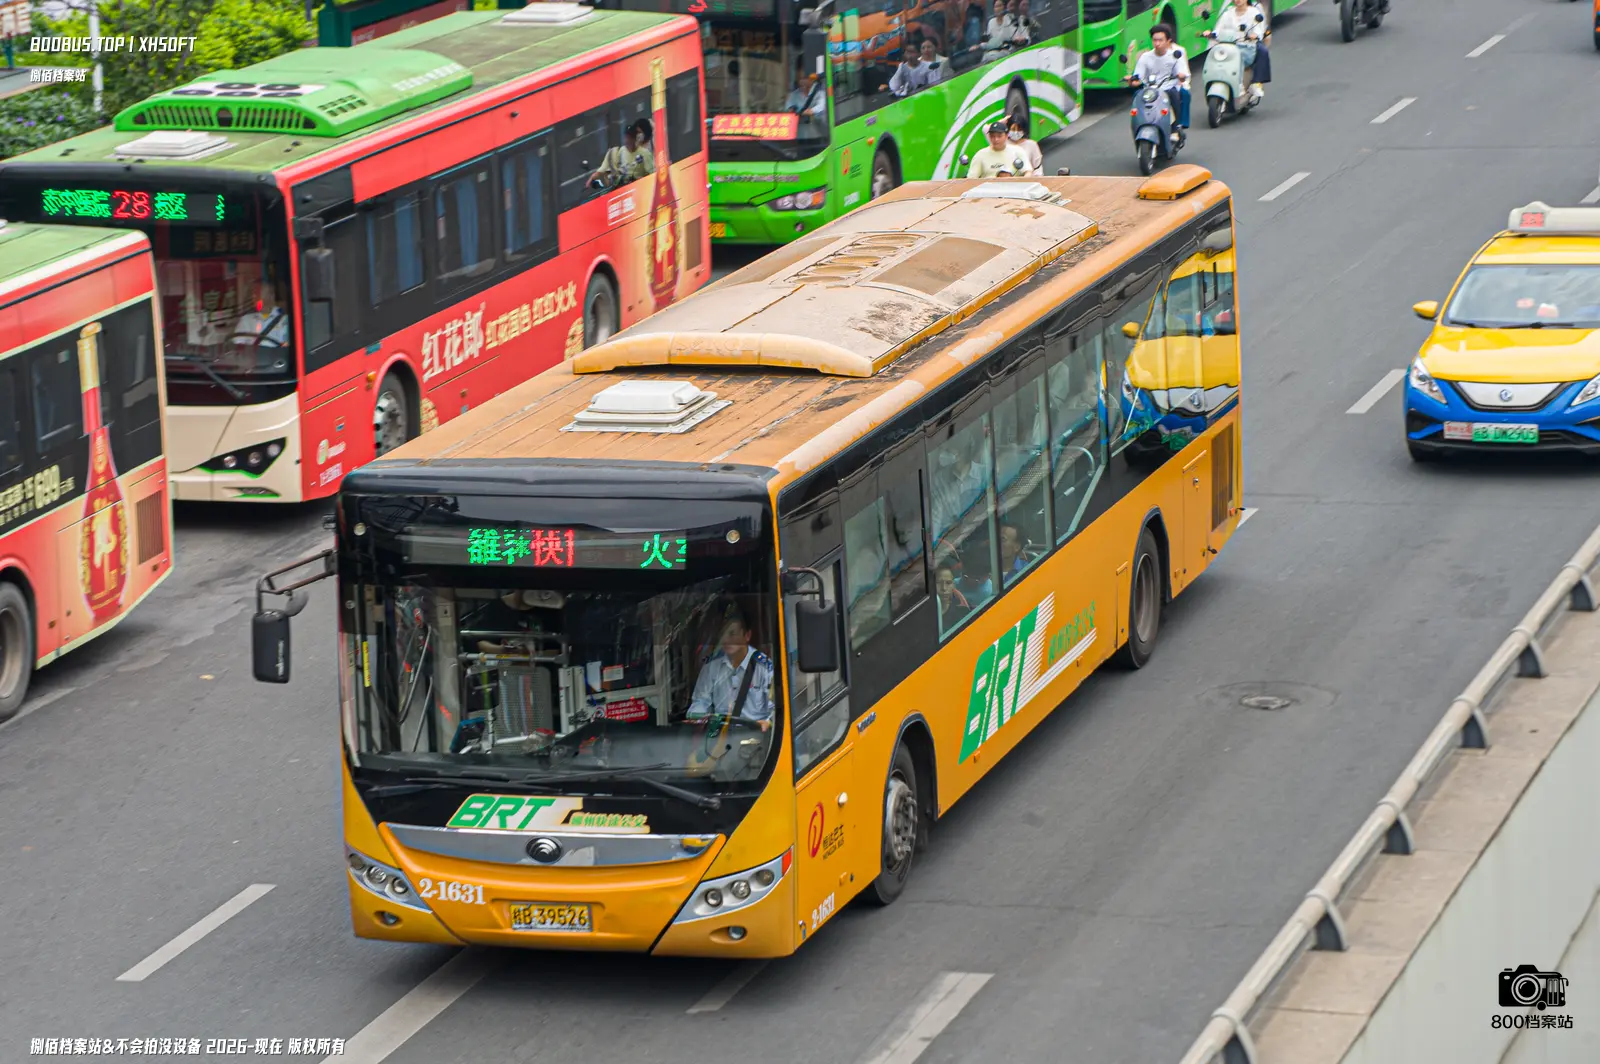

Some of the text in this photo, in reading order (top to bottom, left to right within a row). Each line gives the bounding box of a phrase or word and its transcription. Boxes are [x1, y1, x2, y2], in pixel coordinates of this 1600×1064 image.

[112, 190, 150, 219] 28
[421, 310, 485, 383] 红花郎
[958, 604, 1039, 765] BRT
[449, 795, 557, 830] BRT
[419, 877, 487, 905] 2-1631
[811, 892, 836, 930] 2-1631
